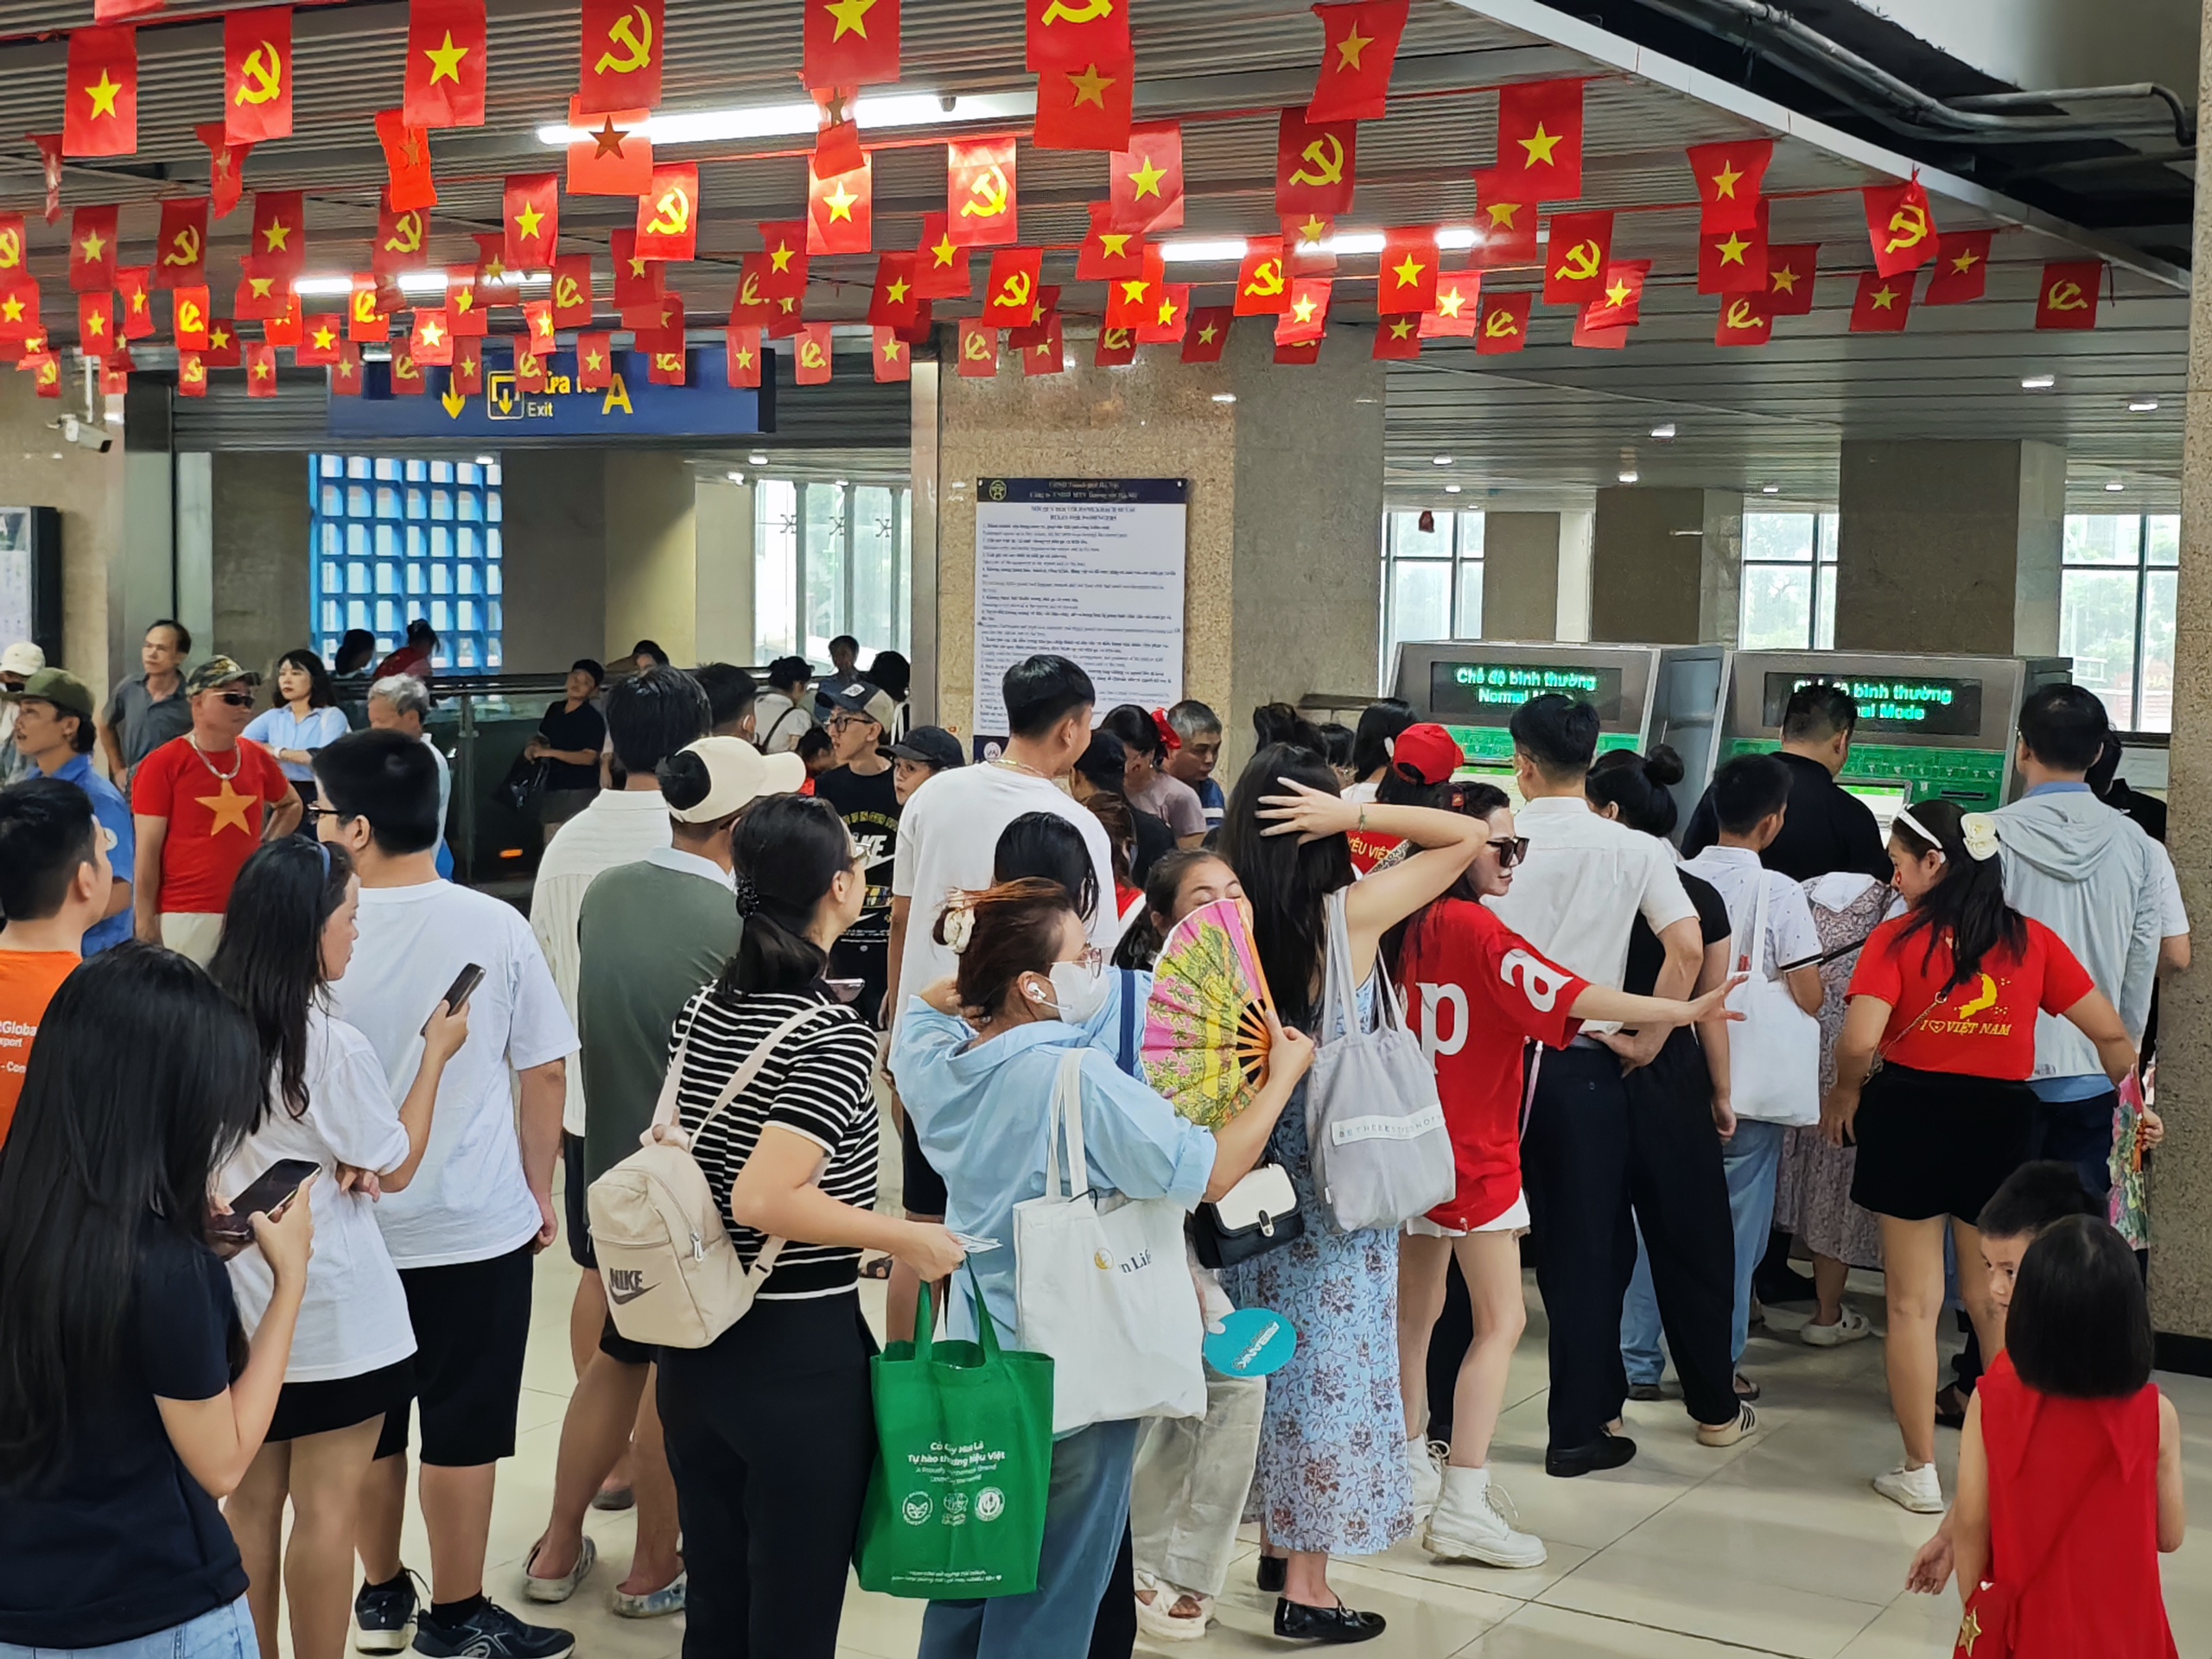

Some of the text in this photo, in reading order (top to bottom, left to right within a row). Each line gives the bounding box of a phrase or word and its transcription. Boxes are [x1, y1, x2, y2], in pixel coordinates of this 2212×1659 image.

[601, 372, 634, 415] A
[527, 401, 554, 417] Exit
[1478, 688, 1529, 704] Normal
[1879, 703, 1926, 721] Mode
[0, 1020, 38, 1036] Globa
[1947, 1019, 1980, 1036] VIỆT
[1979, 1023, 2012, 1036] NAM
[1130, 1249, 1152, 1270] Lif
[609, 1267, 644, 1292] NIKE
[944, 1443, 957, 1455] Cy
